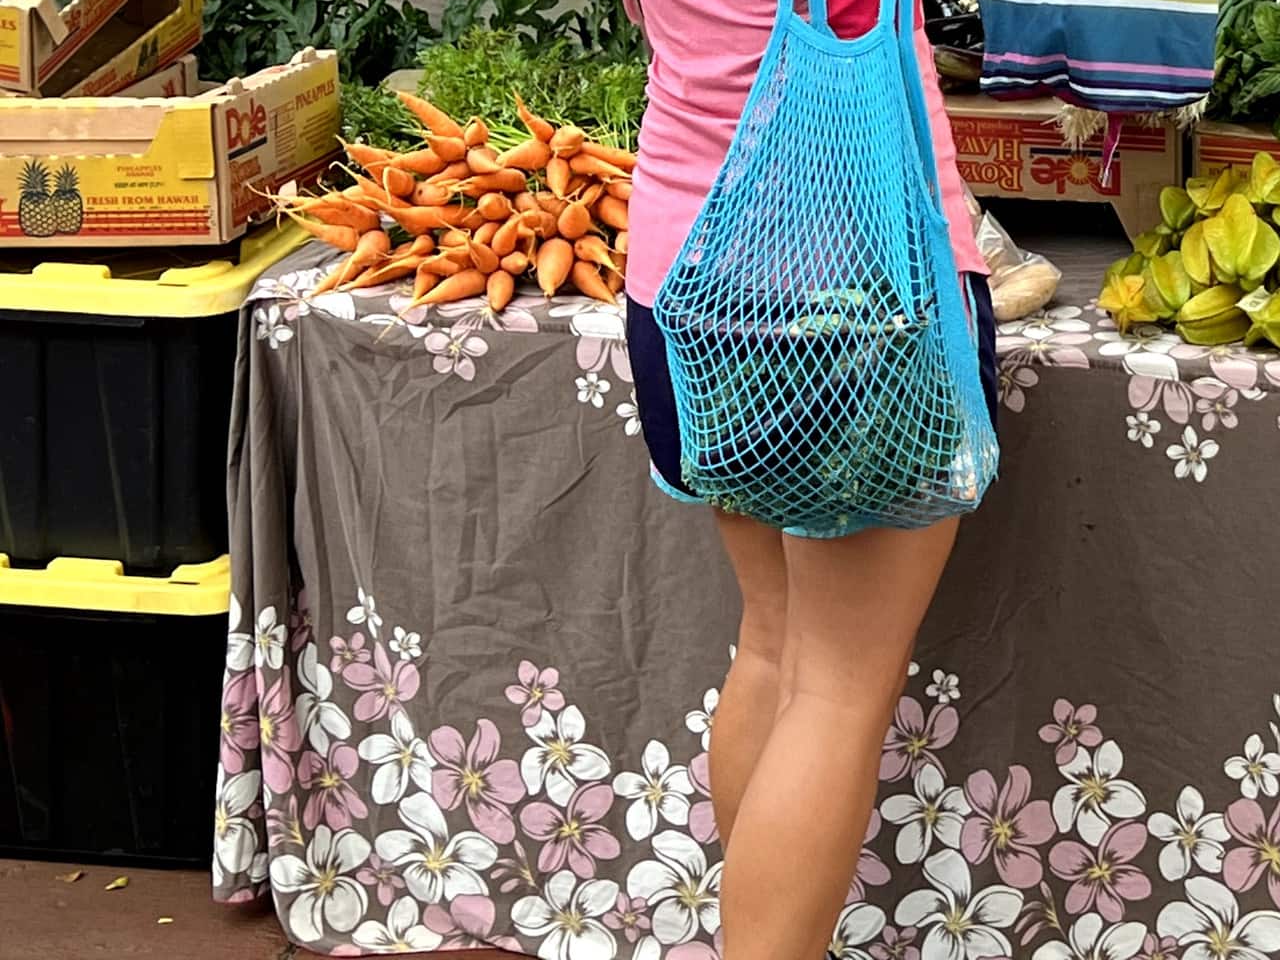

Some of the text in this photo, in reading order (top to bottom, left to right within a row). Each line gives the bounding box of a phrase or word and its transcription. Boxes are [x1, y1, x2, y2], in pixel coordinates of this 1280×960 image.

[295, 79, 336, 112] PINEAPPLES
[226, 98, 267, 149] Dole
[959, 159, 1024, 193] ROYA
[87, 194, 199, 205] FRESH FROM HAWAII
